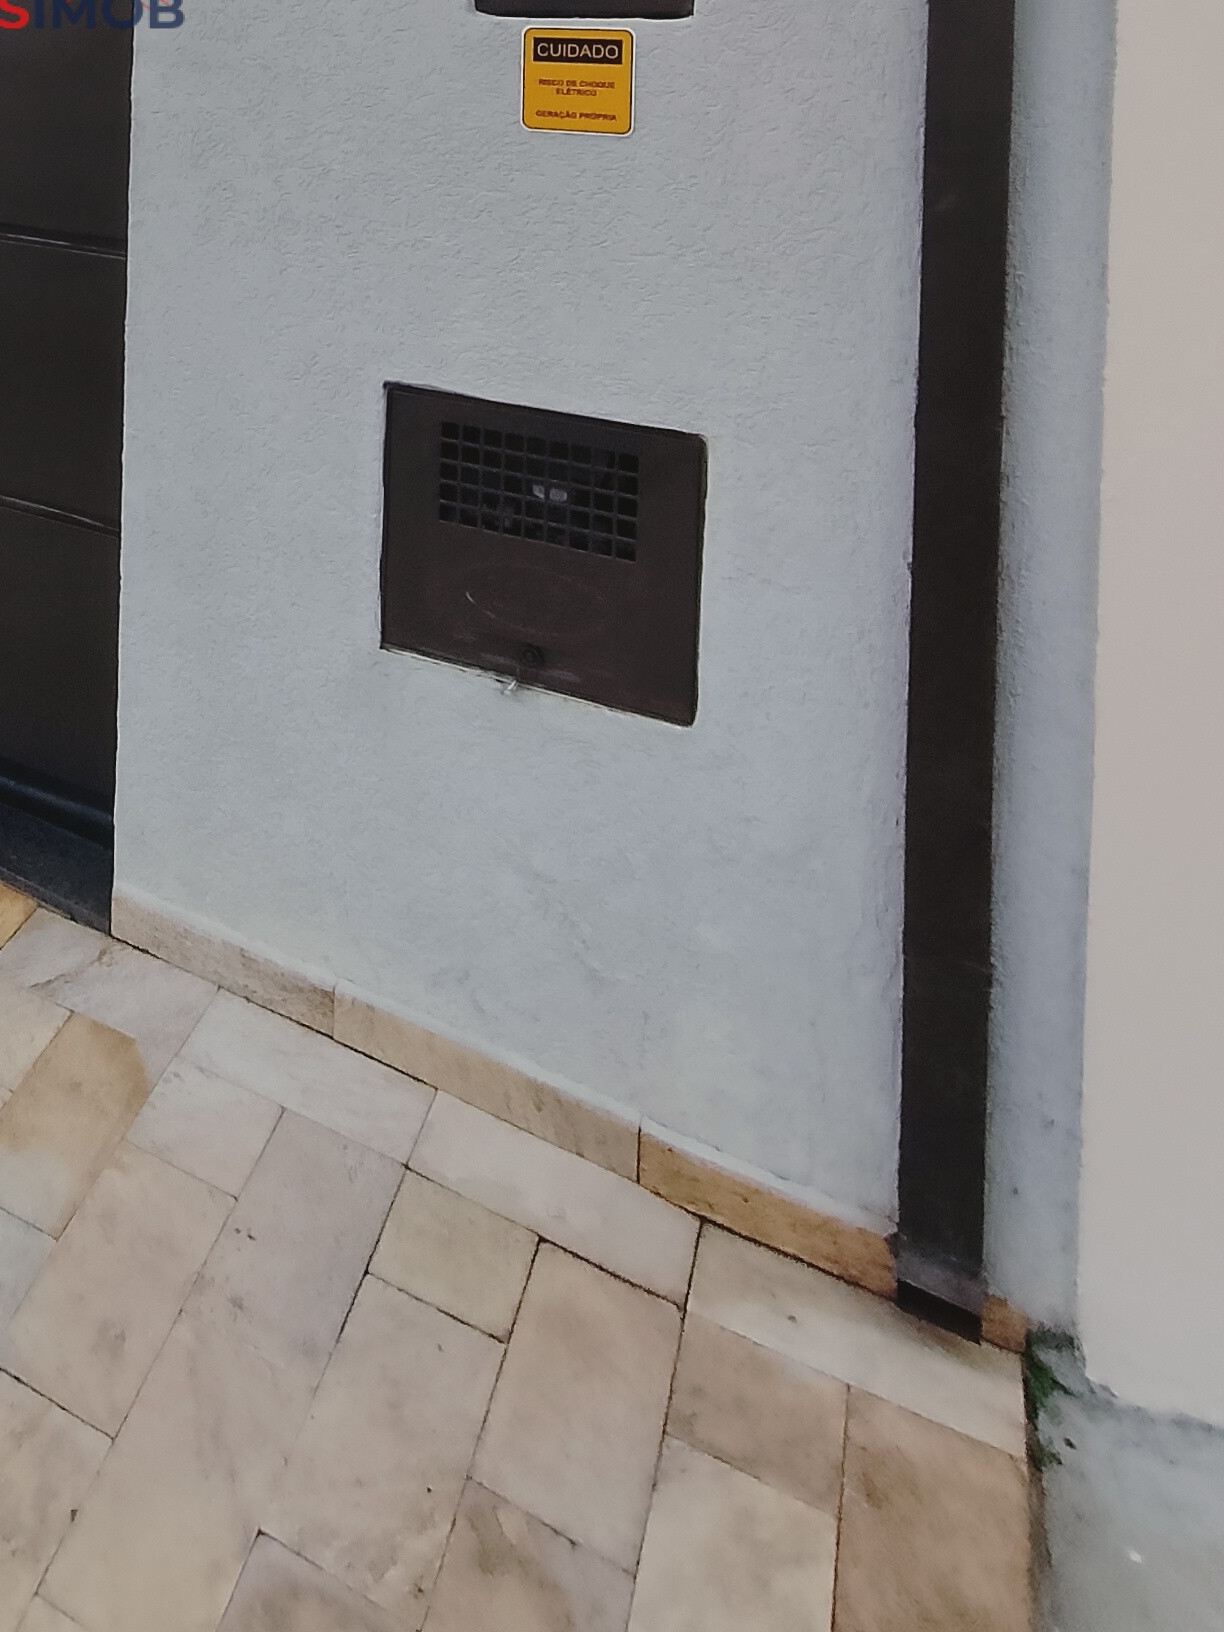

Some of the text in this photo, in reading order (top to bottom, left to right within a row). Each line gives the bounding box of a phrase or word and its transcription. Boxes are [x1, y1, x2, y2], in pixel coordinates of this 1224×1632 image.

[537, 42, 619, 59] CUIDADO
[538, 78, 616, 89] RISCO DE CHOQUE
